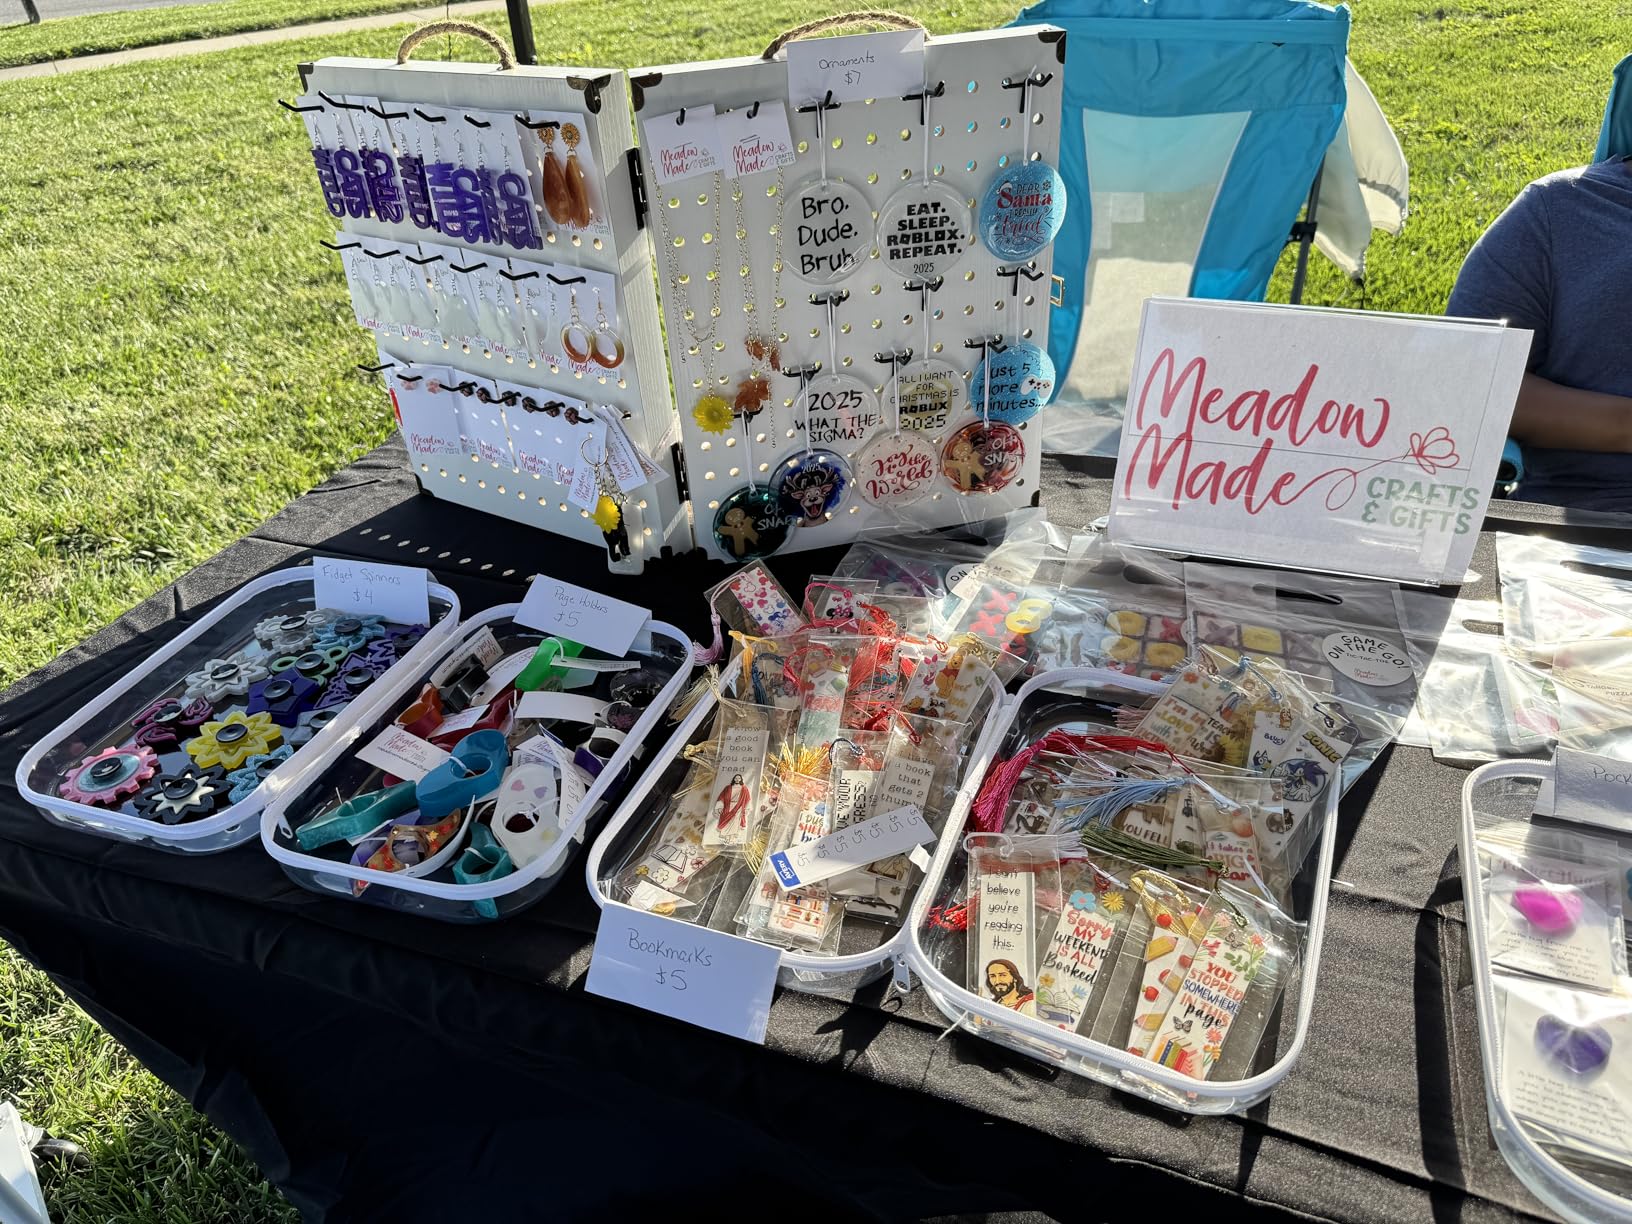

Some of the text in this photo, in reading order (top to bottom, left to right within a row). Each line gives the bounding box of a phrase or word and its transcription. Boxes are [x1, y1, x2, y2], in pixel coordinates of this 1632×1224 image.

[818, 49, 875, 70] Ornaments
[844, 69, 862, 85] $7
[660, 144, 698, 163] Meadow
[732, 139, 774, 162] Meadow
[663, 162, 692, 178] Made
[735, 158, 767, 177] Made
[801, 196, 850, 219] Bro.
[906, 201, 946, 217] EAT.
[897, 215, 956, 232] SLEEP.
[797, 219, 859, 247] Dude.
[886, 229, 966, 247] ROBLOX.
[889, 243, 963, 260] REPEAT.
[913, 262, 935, 274] 2025
[898, 375, 917, 384] ALL
[924, 371, 954, 381] WANT
[981, 363, 1031, 380] ust 5
[916, 383, 934, 391] FOR
[950, 389, 960, 397] IS
[808, 390, 864, 412] 2025
[1136, 347, 1391, 449] Meadow
[899, 401, 948, 415] ROBUX
[846, 414, 878, 428] THE
[900, 414, 947, 430] 2025
[809, 429, 865, 443] SIGMA?
[801, 463, 821, 474] 2025
[907, 453, 929, 466] the
[1125, 422, 1310, 516] Made
[866, 460, 933, 499] World
[1366, 476, 1481, 511] CRAFTS
[1361, 501, 1472, 536] & GIFTS
[322, 564, 401, 585] Fidget Spinners
[554, 585, 609, 614] Page Holders
[553, 610, 582, 628] $5
[1341, 635, 1389, 651] GAME
[1328, 643, 1410, 669] ON THE GO!
[1302, 730, 1343, 764] SONIC
[905, 763, 932, 777] book
[898, 774, 922, 786] that
[888, 784, 913, 797] gets
[1144, 829, 1169, 844] FELL
[777, 859, 795, 881] AVERY
[986, 882, 1021, 896] believe
[988, 900, 1019, 914] you're
[984, 918, 1023, 933] reading
[1066, 908, 1114, 941] Sorry
[993, 935, 1015, 949] this.
[1072, 926, 1097, 942] MY
[627, 927, 713, 968] Bookmarks
[1054, 930, 1109, 960] WEEKEND
[1057, 941, 1096, 969] IS ALL
[655, 963, 688, 991] $5
[1042, 951, 1099, 985] Booked
[1207, 961, 1238, 984] YOU
[1188, 967, 1245, 1002] STOPPED
[1183, 978, 1243, 1016] SOMEWHERE
[1179, 992, 1231, 1027] IN THIS
[1183, 1003, 1226, 1030] page
